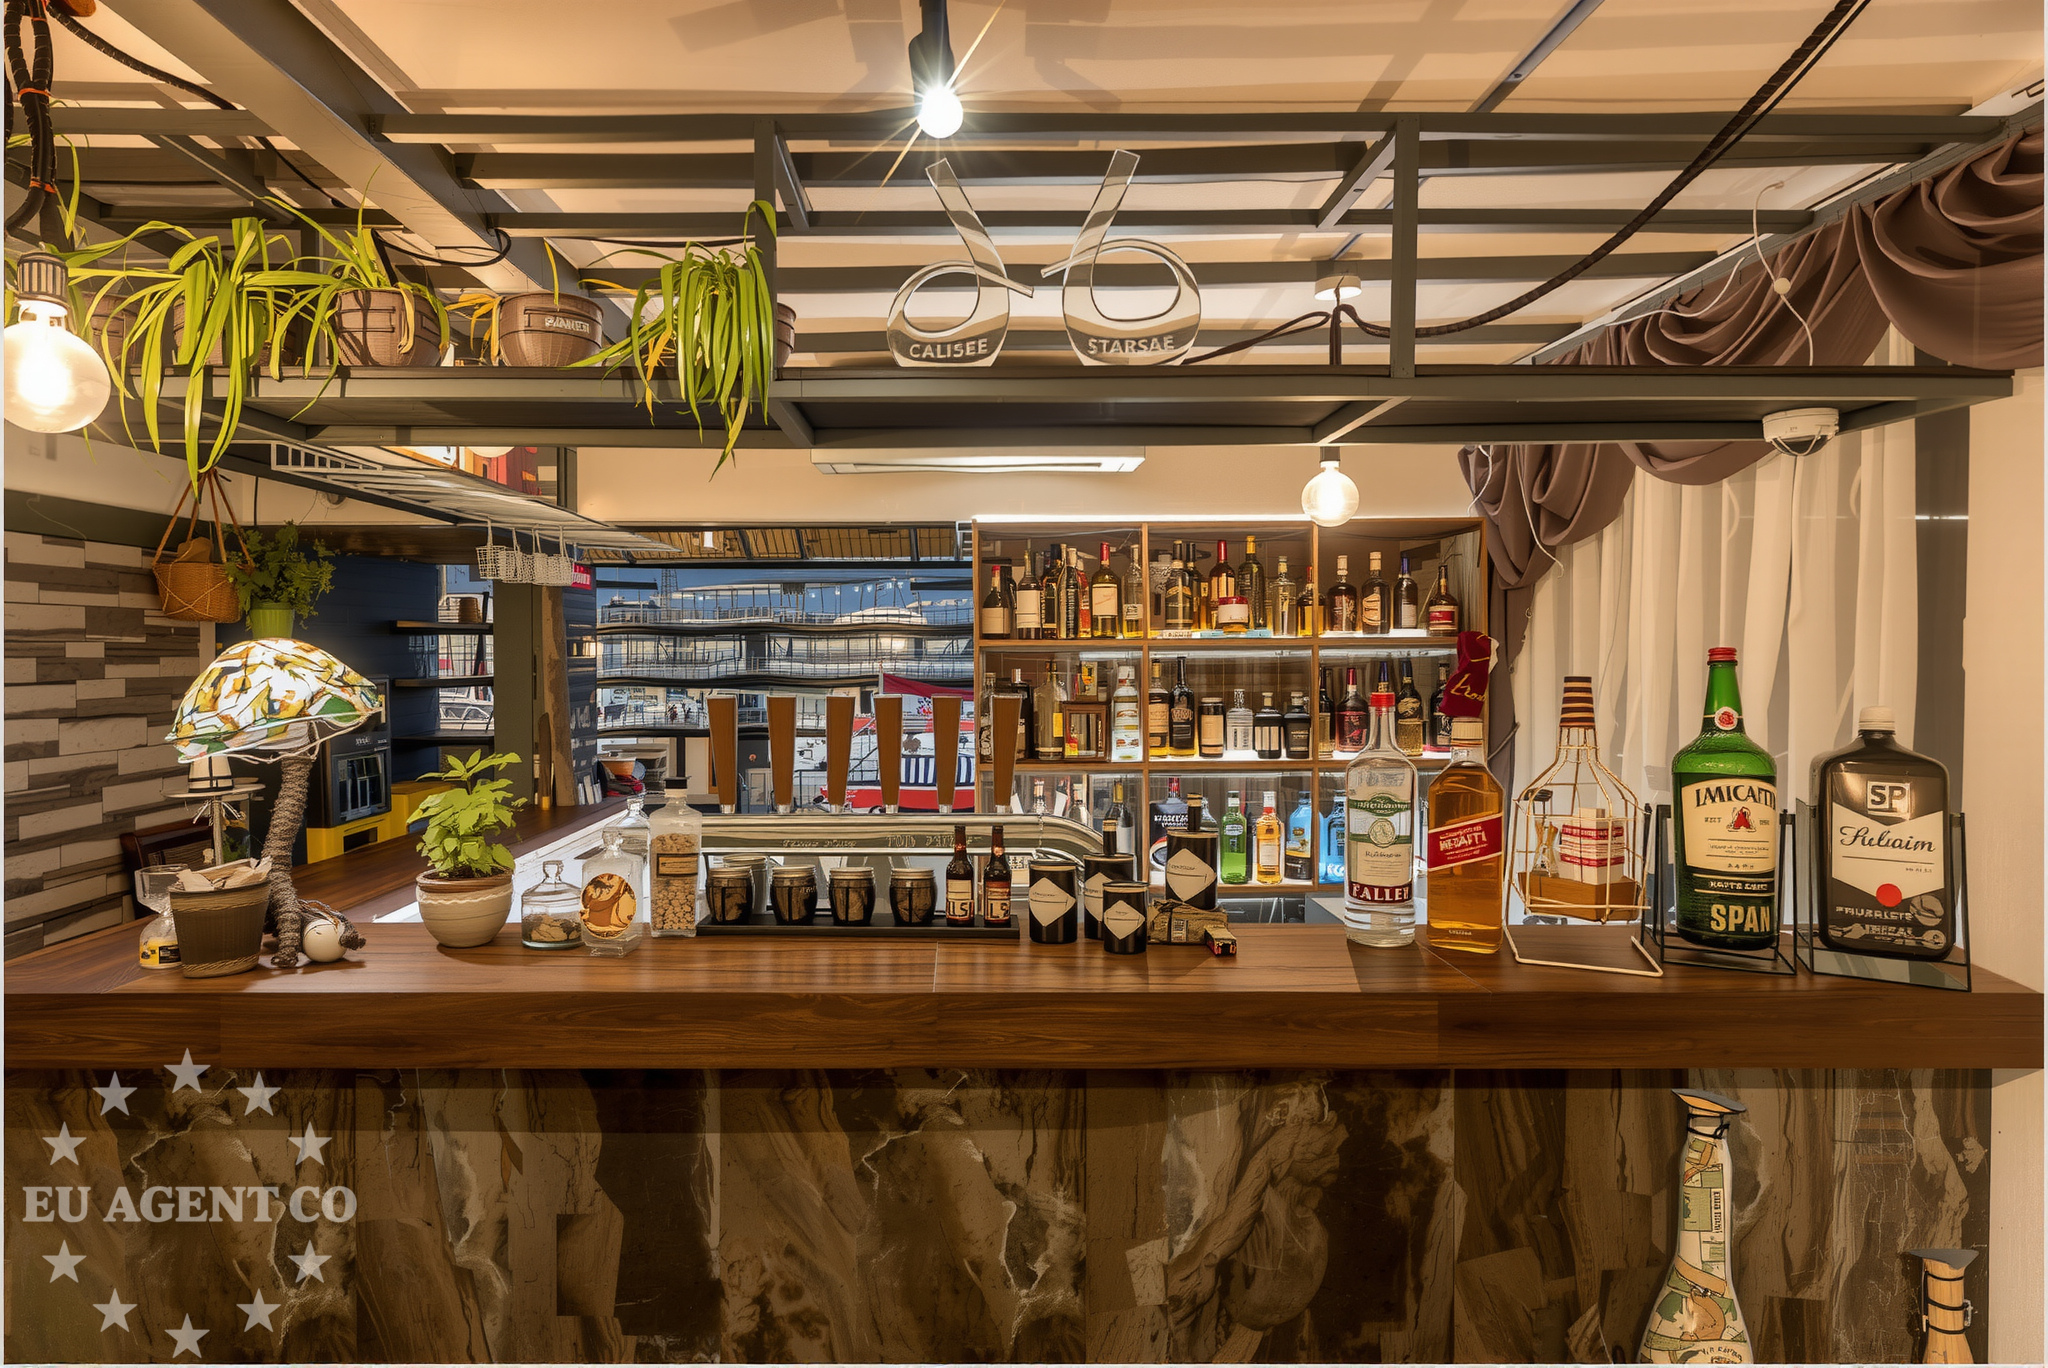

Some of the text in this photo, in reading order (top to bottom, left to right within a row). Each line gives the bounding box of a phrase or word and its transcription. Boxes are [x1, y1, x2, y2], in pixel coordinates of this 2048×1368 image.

[909, 338, 988, 359] CALISEE
[1087, 335, 1175, 355] STARSAE
[1870, 784, 1906, 810] SP
[1710, 904, 1771, 932] SPAN
